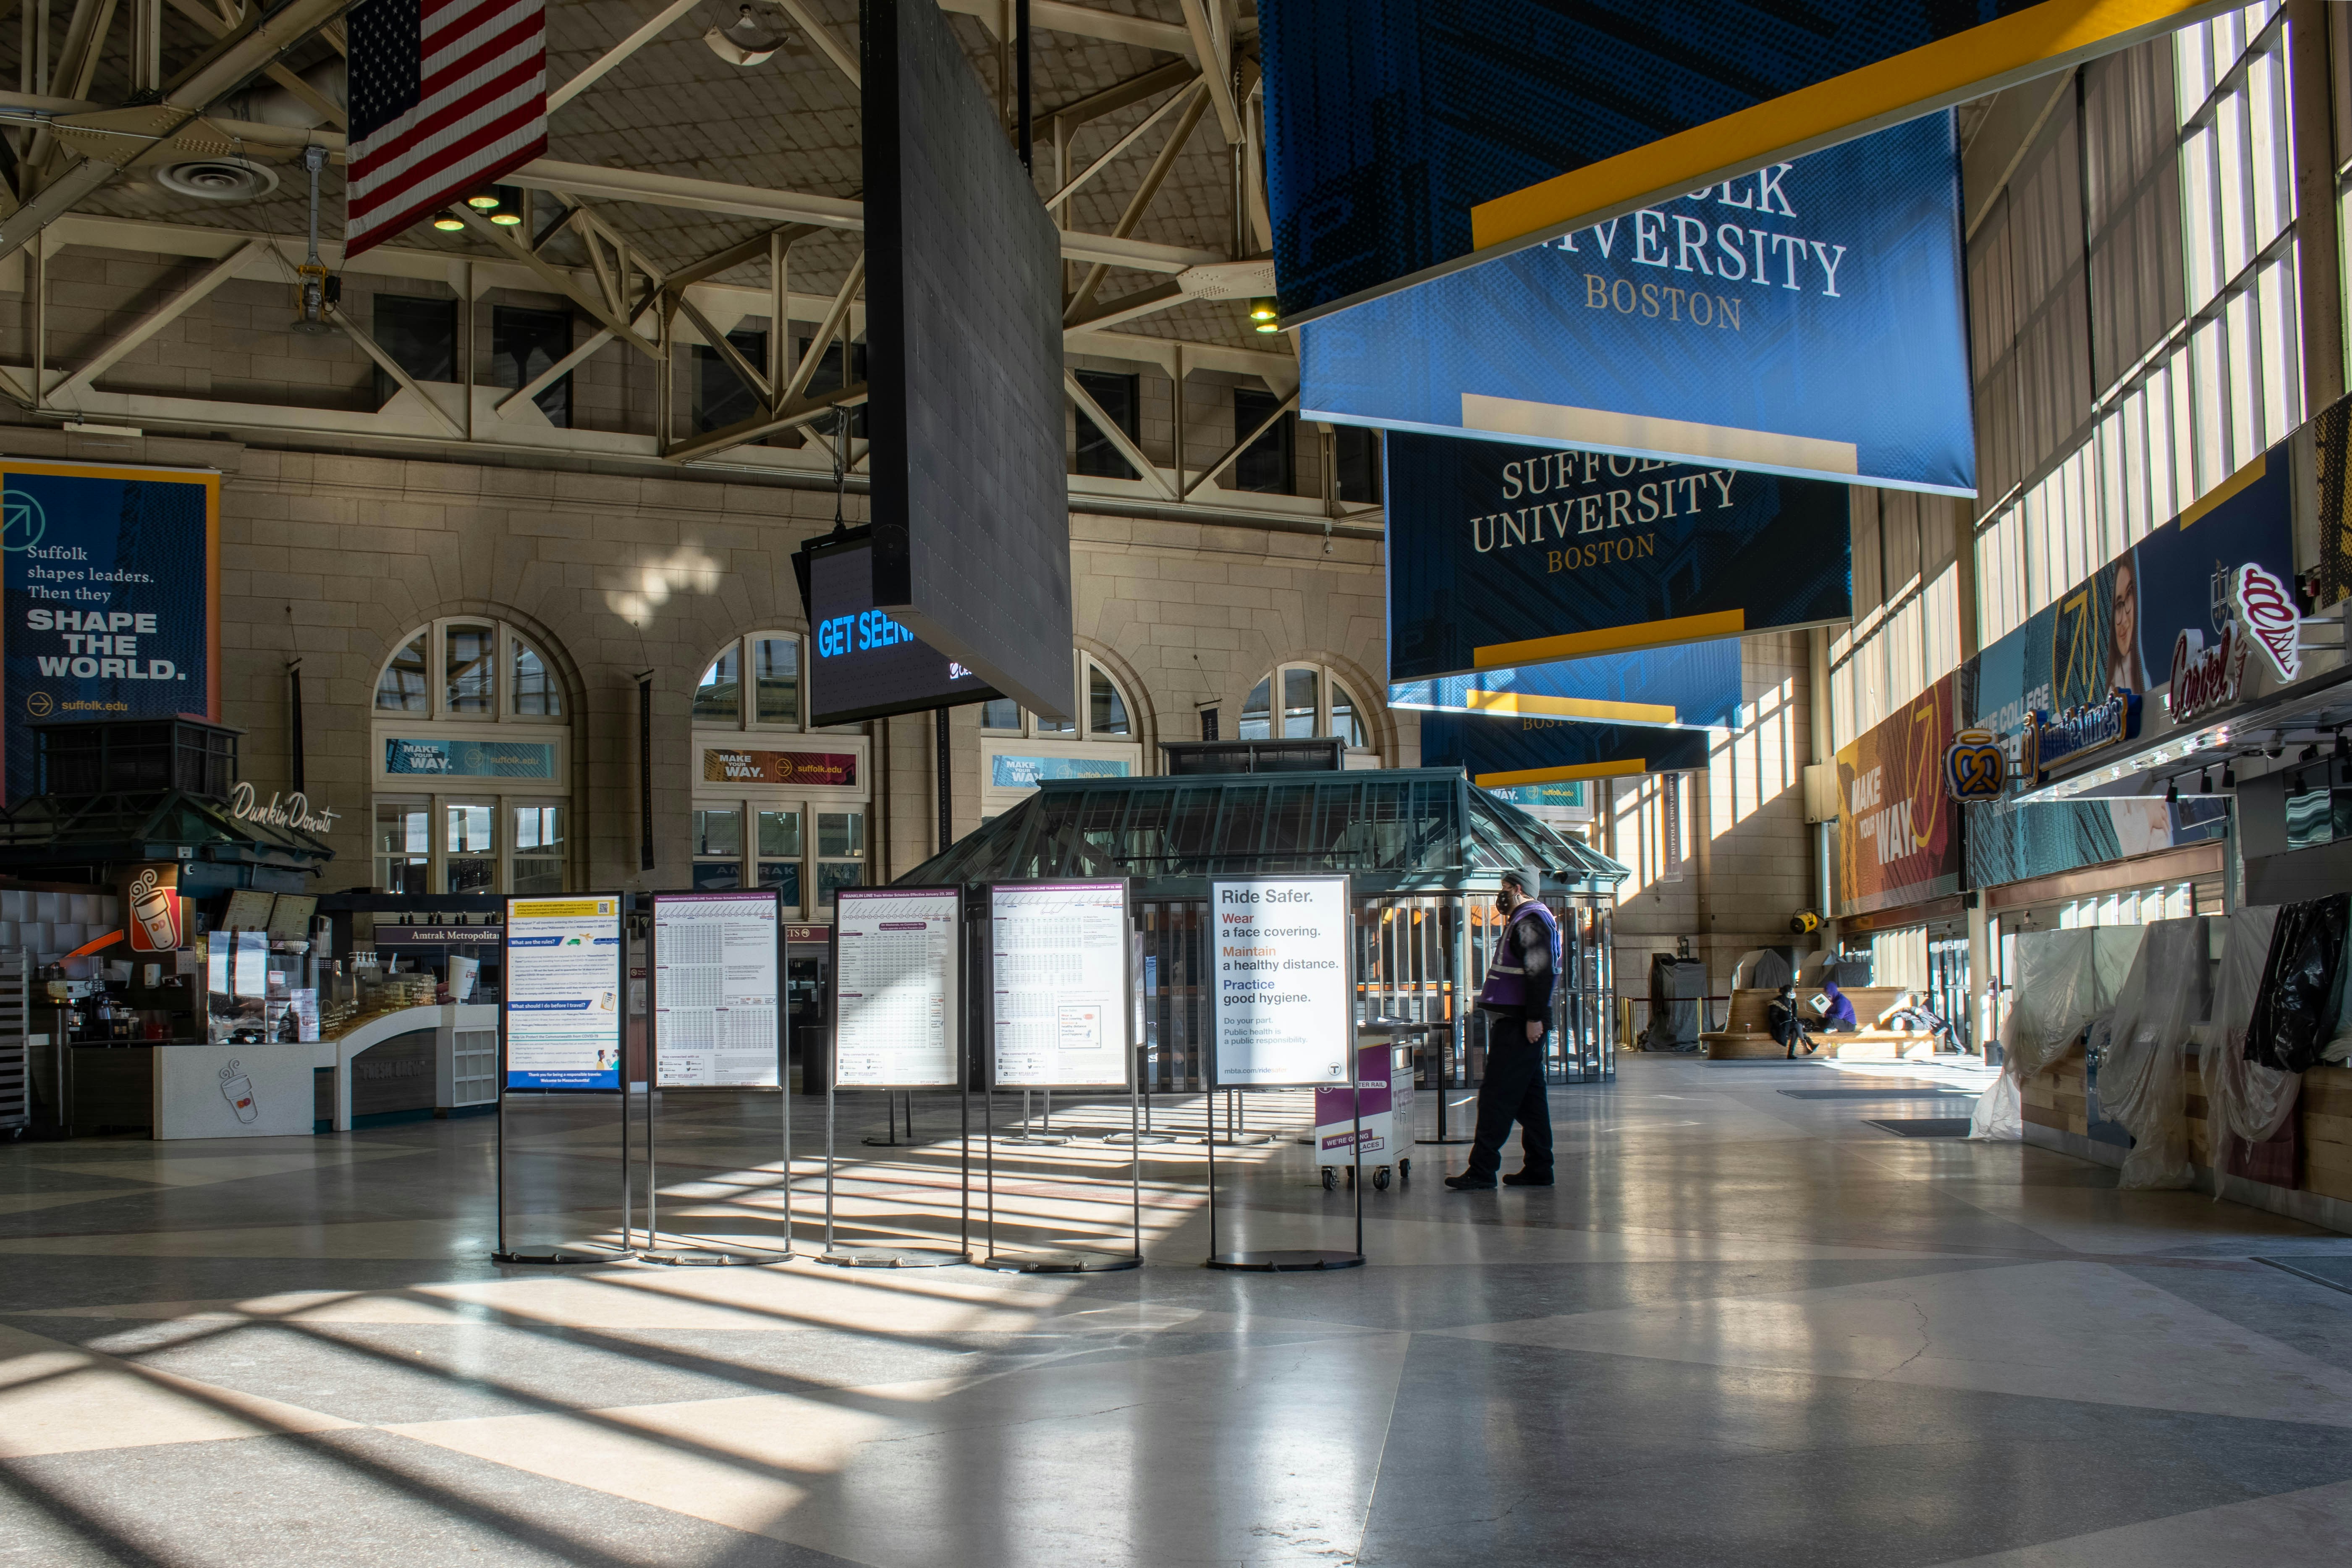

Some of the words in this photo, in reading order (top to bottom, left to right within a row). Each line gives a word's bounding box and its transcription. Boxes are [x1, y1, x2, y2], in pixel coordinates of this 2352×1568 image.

[1584, 274, 1741, 330] BOSTON
[1502, 451, 1682, 499] SUFFOL
[1470, 469, 1738, 553] UNIVERSITY
[27, 546, 87, 560] Suffolk
[1547, 533, 1655, 573] BOSTON
[27, 565, 84, 582] shapes
[89, 568, 154, 583] leaders.
[27, 585, 70, 599] Then
[75, 586, 111, 603] they
[27, 609, 157, 633] SHAPE
[62, 634, 137, 656] THE
[818, 615, 855, 658] GET
[37, 656, 186, 680] WORLD.
[2170, 626, 2230, 719] Carvel
[62, 700, 128, 712] suffolk.edu
[2000, 683, 2049, 731] COLLEGE
[410, 758, 453, 769] WAY.
[490, 756, 538, 765] suffolk.edu
[726, 767, 764, 777] WAY.
[1852, 766, 1881, 815] MAKE
[285, 793, 341, 832] Donuts
[1860, 815, 1875, 839] YOUR
[1876, 798, 1917, 865] WAY.
[1222, 889, 1260, 903] Ride
[1265, 889, 1312, 903] Safer.
[1222, 913, 1253, 923] Wear
[1234, 927, 1260, 937] face
[1264, 926, 1320, 938] covering.
[1223, 945, 1276, 957] Maintain
[1234, 959, 1278, 971] healthy
[1283, 959, 1338, 969] distance.
[1223, 979, 1274, 990] Practice
[1223, 993, 1255, 1006] good
[1259, 992, 1310, 1005] hygiene.
[1231, 1037, 1254, 1045] public
[1327, 1138, 1347, 1147] WE'RE
[1349, 1133, 1369, 1141] GNG
